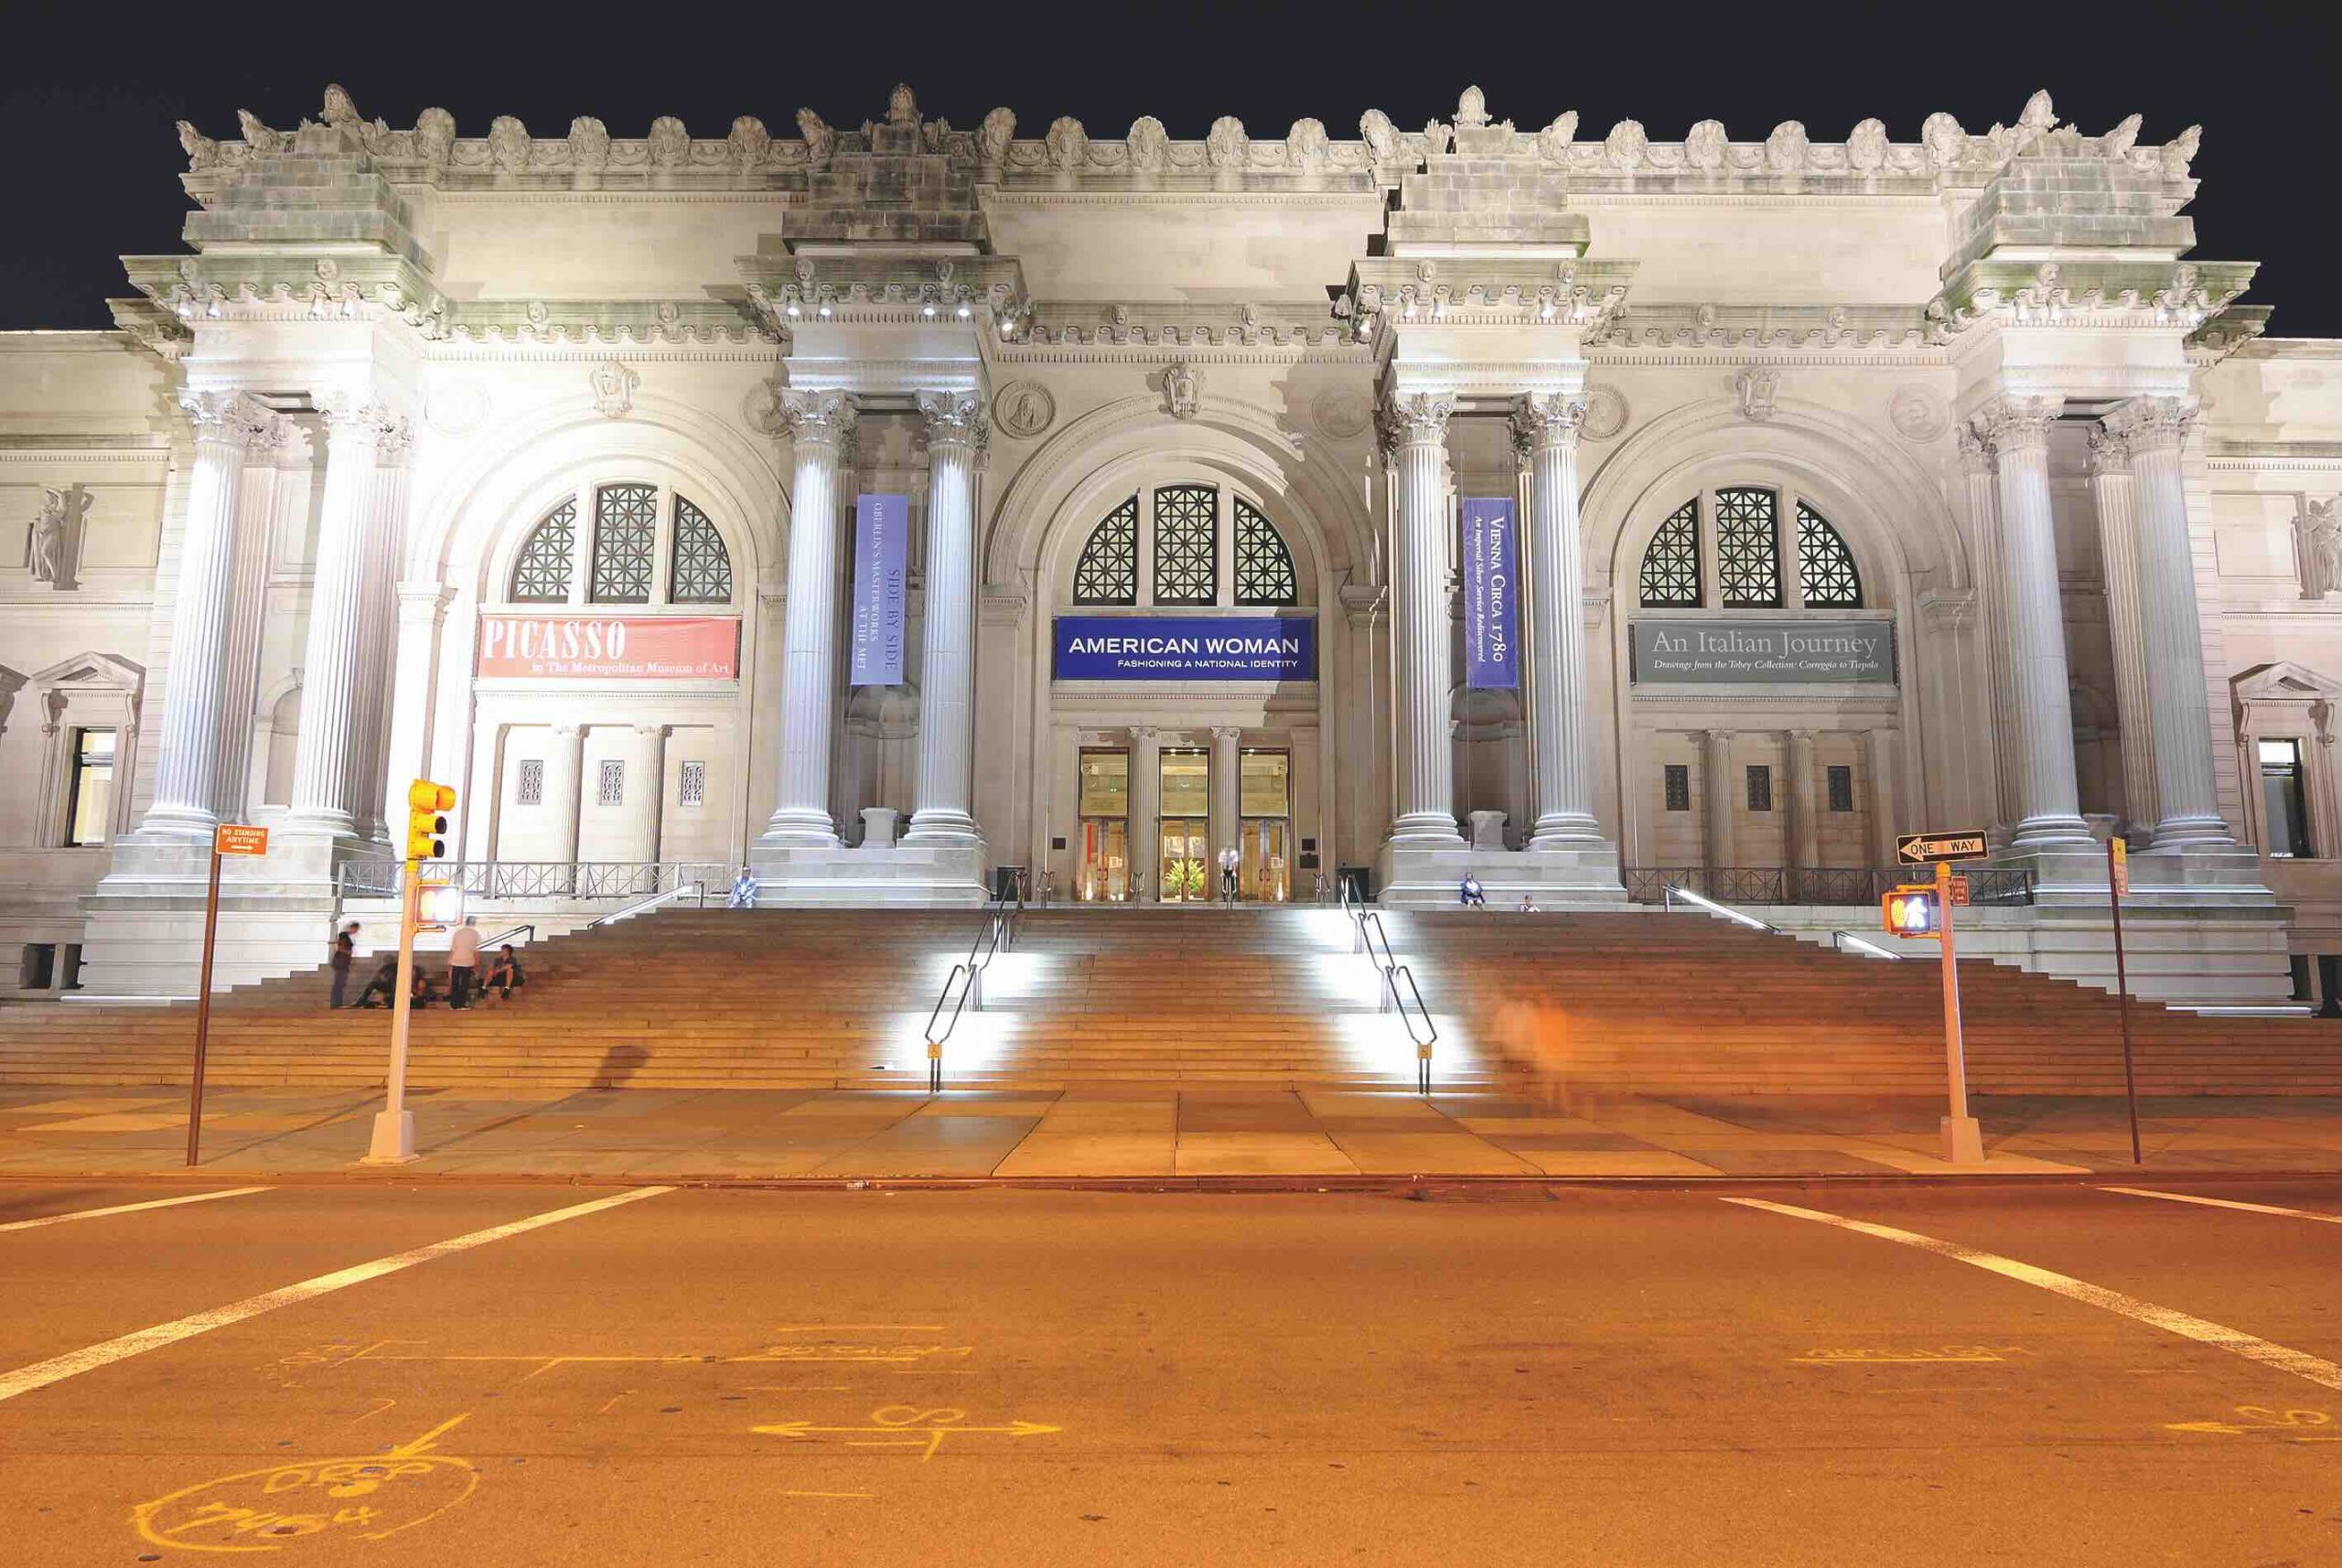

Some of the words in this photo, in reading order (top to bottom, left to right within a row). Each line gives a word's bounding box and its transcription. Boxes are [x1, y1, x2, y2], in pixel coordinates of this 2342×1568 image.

[1475, 516, 1483, 529] An
[1474, 529, 1484, 561] Imperial
[1475, 563, 1484, 585] Silver
[886, 568, 899, 605] SIDE
[870, 561, 882, 642] MASTERWORKS
[1476, 585, 1485, 612] Service
[858, 605, 868, 620] AT
[886, 610, 898, 628] BY
[484, 620, 626, 660] PICASSO
[857, 622, 868, 643] THE
[1477, 614, 1486, 662] Rediscovered
[1490, 625, 1506, 662] 1780
[885, 635, 897, 671] SIDE
[1069, 638, 1198, 654] AMERICAN
[1205, 638, 1300, 654] WOMAN
[1651, 631, 1689, 652] An
[1698, 630, 1772, 652] Italian
[1778, 631, 1877, 659] Journey
[532, 662, 543, 672] in
[548, 661, 569, 672] The
[573, 661, 643, 675] Metropolitan
[647, 662, 693, 673] Museum
[696, 662, 707, 673] of
[709, 662, 729, 673] Art
[856, 647, 867, 671] MET
[1117, 660, 1182, 669] FASHIONING
[1184, 660, 1193, 669] A
[1195, 660, 1248, 669] NATIONAL
[1251, 660, 1298, 669] IDENTITY
[1654, 660, 1692, 671] Drawings
[1691, 660, 1713, 671] from
[1714, 660, 1727, 669] the
[1755, 660, 1796, 669] Collection:
[1839, 660, 1848, 669] to
[234, 829, 265, 837] STANDING
[1910, 843, 1935, 854] ONE
[1950, 840, 1975, 852] WAY
